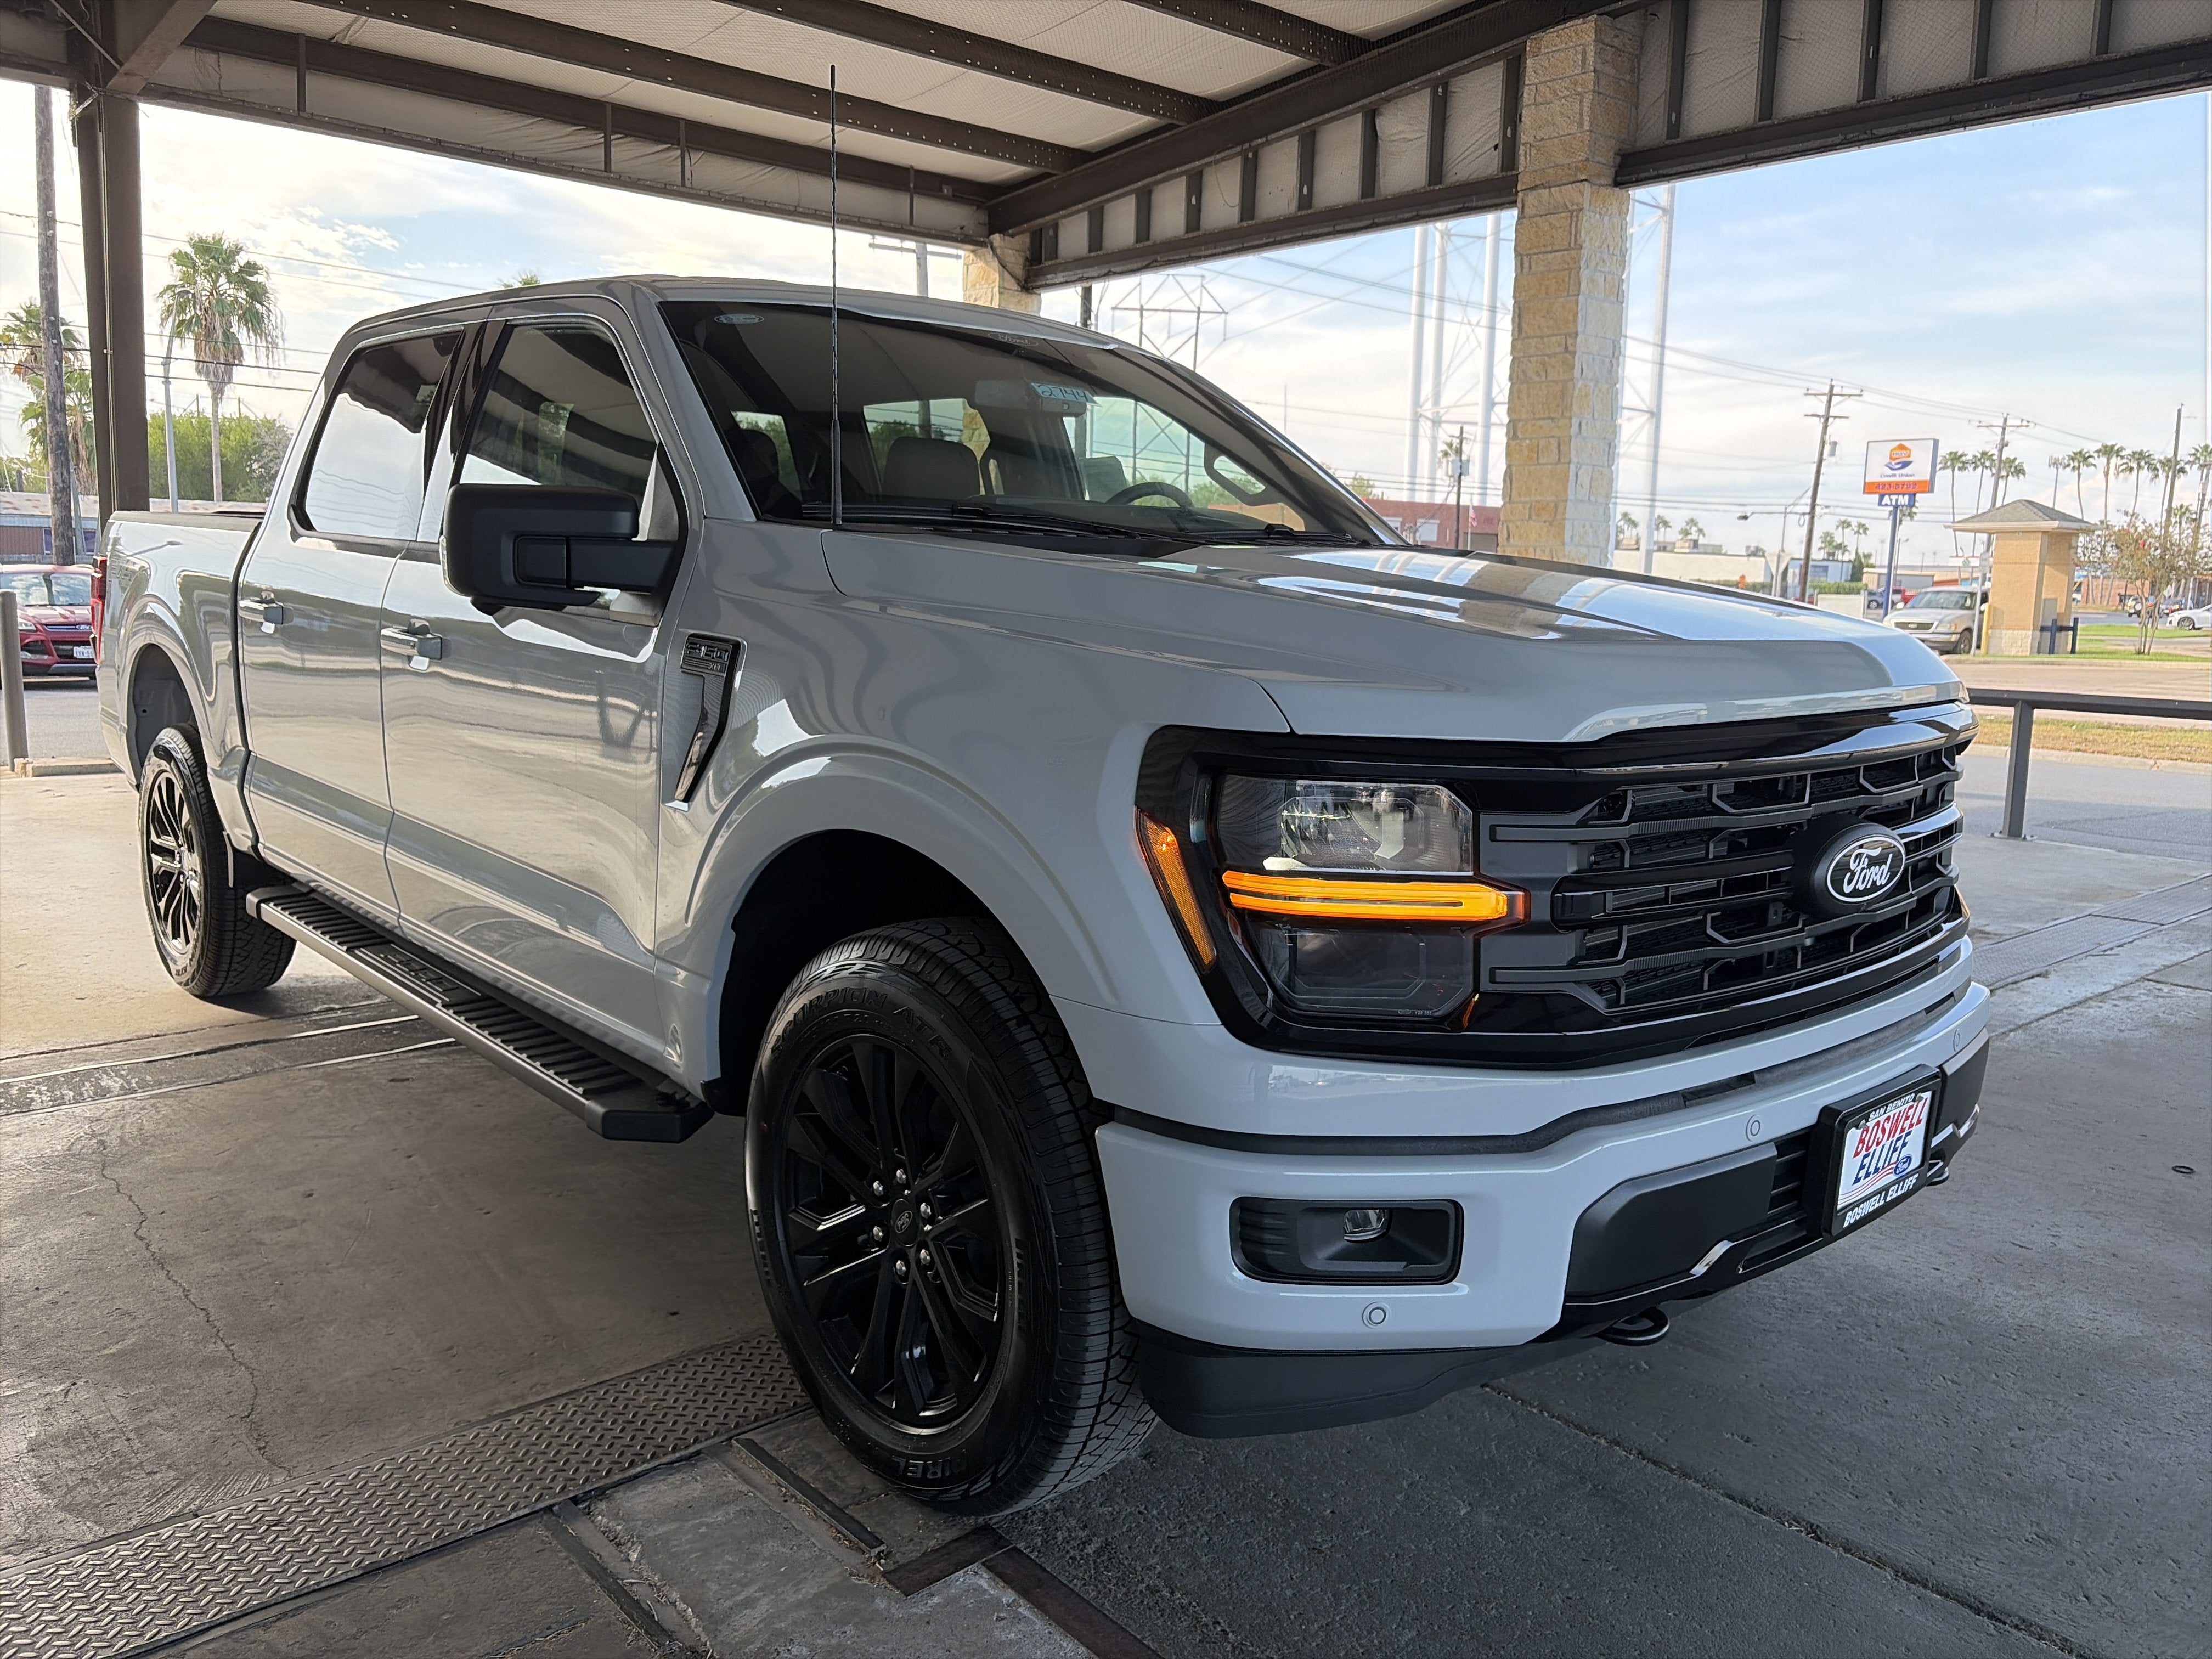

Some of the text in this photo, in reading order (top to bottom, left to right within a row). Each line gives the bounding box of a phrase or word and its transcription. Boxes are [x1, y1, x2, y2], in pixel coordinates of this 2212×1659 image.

[1038, 385, 1089, 402] 2744
[1881, 494, 1909, 505] ATM
[1843, 847, 1893, 894] Ford
[1852, 1098, 1928, 1159] BOSWELL
[1868, 1093, 1915, 1121] SAN BENITO
[1852, 1130, 1912, 1186] ELLIFF
[1843, 1173, 1919, 1229] BOSWELL ELLIFF
